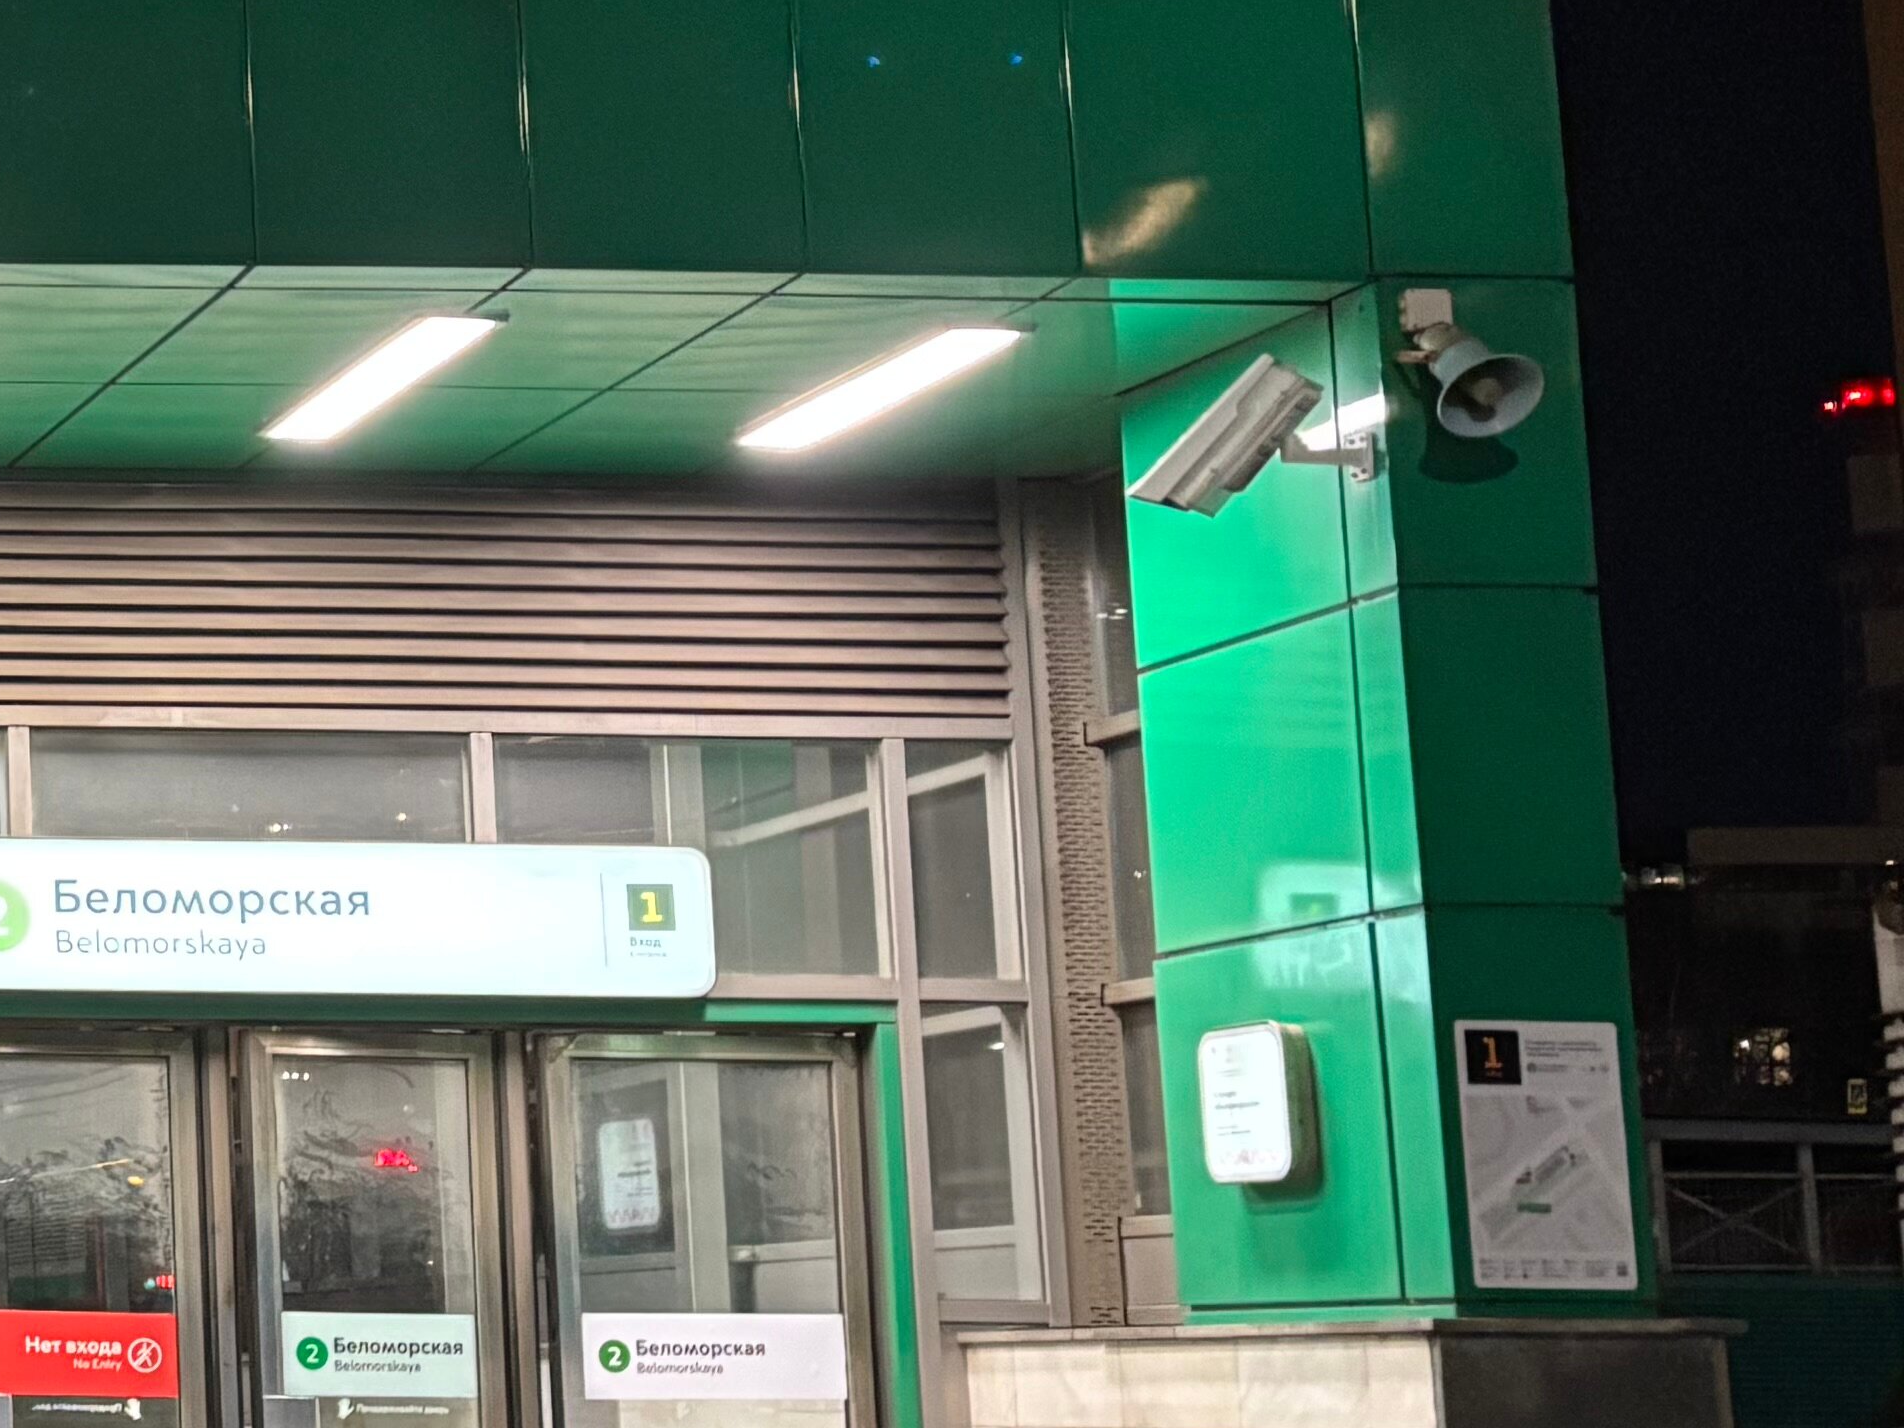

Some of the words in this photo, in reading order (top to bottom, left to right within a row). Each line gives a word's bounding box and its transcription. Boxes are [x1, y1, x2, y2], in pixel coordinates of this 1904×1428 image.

[54, 879, 371, 924] Беломорская
[55, 929, 267, 961] Belomorskaya
[1481, 1036, 1504, 1069] 1
[25, 1335, 62, 1353] Нет
[65, 1340, 122, 1356] входа
[333, 1337, 464, 1358] Беломорская
[635, 1339, 766, 1360] Беломорская
[73, 1358, 90, 1369] No
[334, 1359, 422, 1373] Belomorskaya
